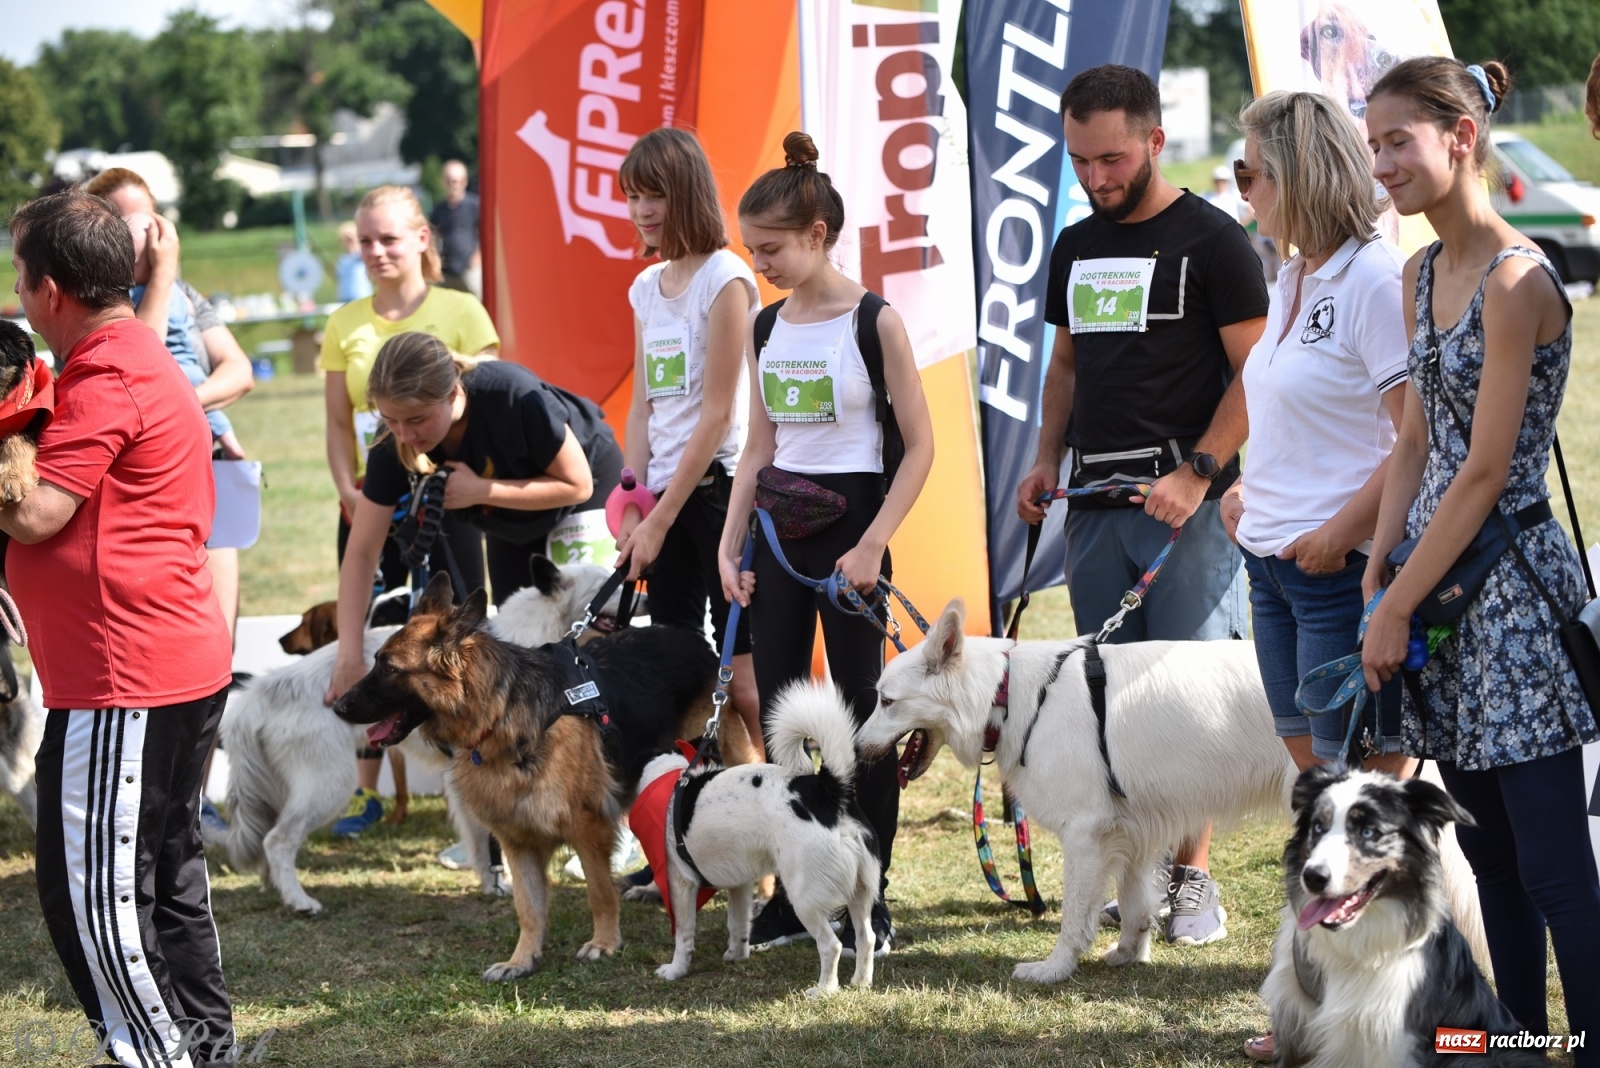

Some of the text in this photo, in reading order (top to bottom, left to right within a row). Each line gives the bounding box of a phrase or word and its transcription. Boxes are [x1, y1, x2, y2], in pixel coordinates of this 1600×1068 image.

[575, 0, 647, 221] FIPRe
[852, 10, 945, 302] Tropi
[978, 0, 1073, 421] FRONTL
[1080, 271, 1141, 281] DOGTREKKING
[1096, 296, 1118, 316] 14
[655, 363, 665, 383] 6
[766, 360, 827, 369] DOGTREKKING
[785, 386, 800, 407] 8
[1107, 488, 1122, 499] 4F
